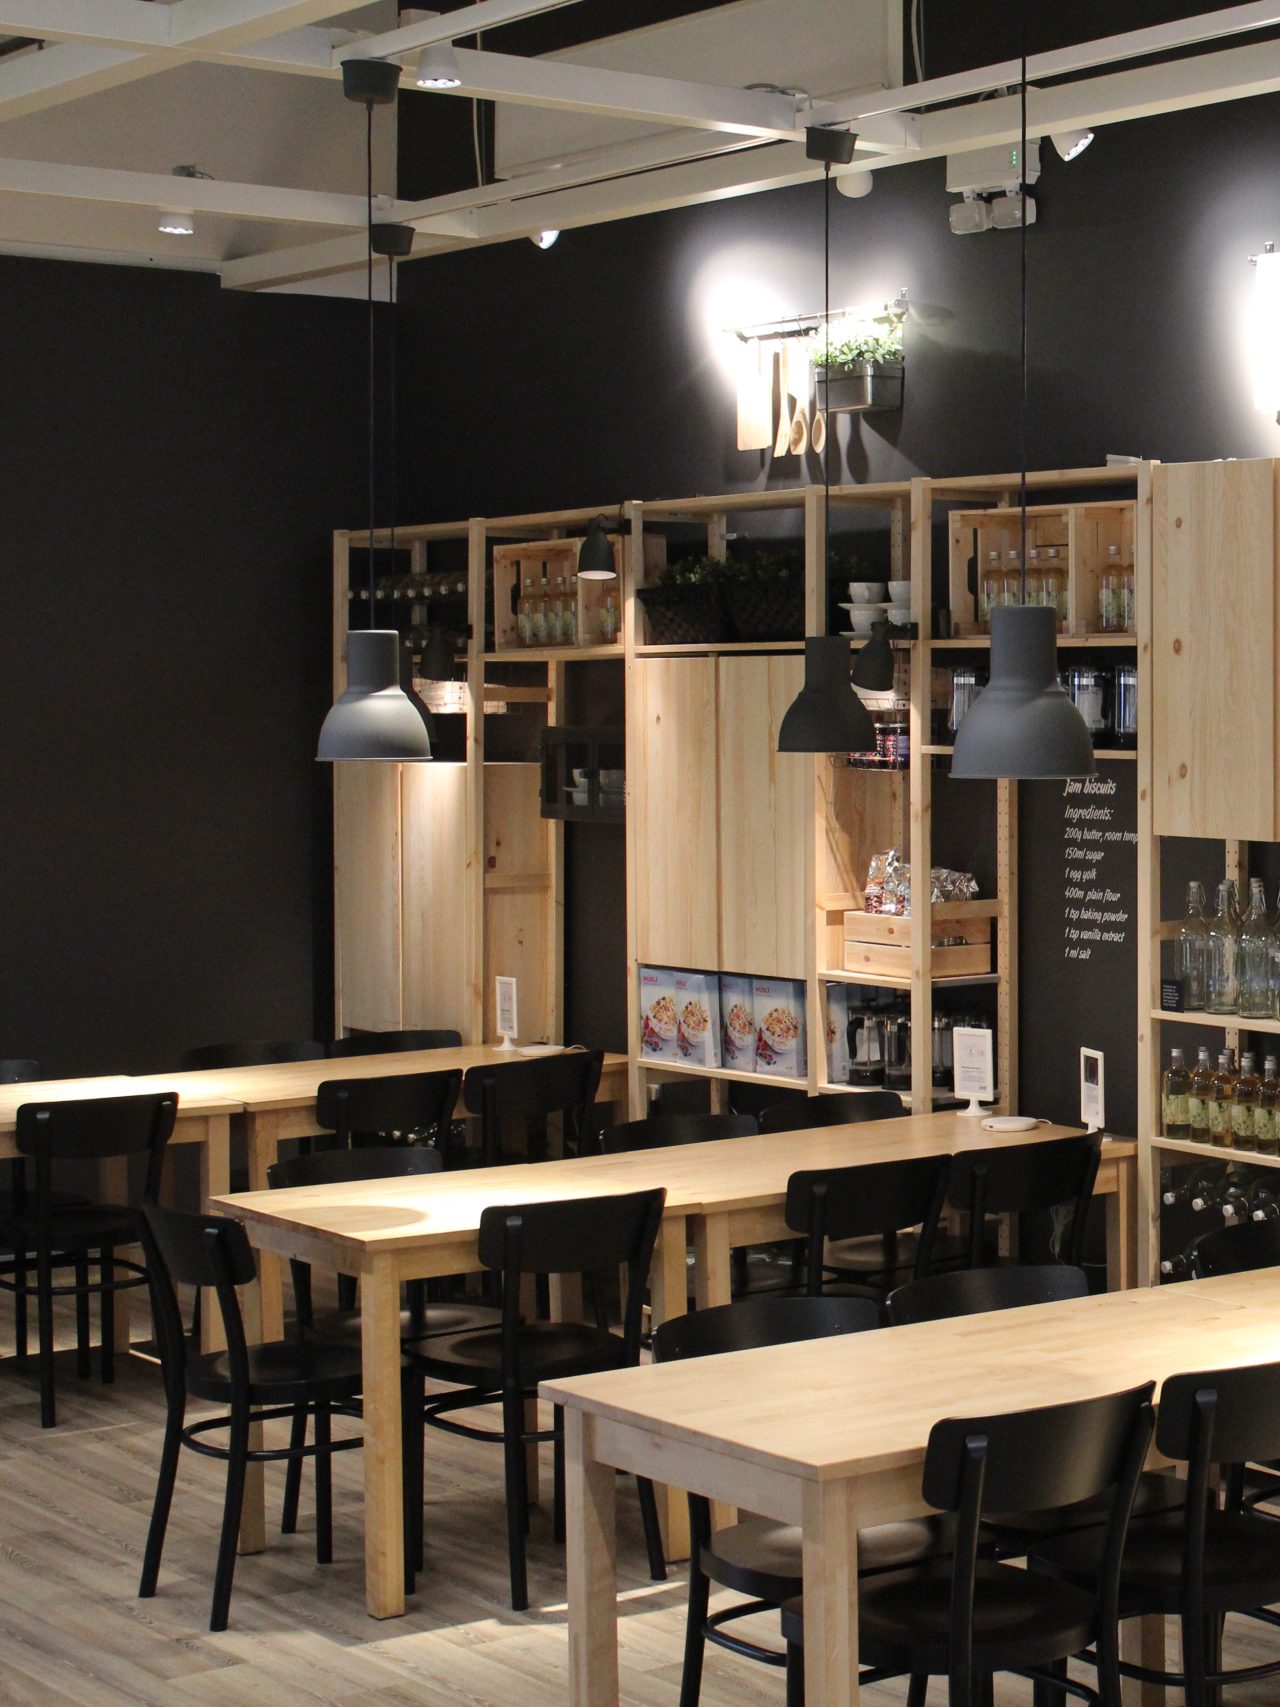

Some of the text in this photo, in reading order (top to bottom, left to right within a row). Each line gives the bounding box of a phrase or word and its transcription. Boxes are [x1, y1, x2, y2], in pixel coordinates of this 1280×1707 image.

[1063, 778, 1117, 797] Jam biscuits
[1065, 805, 1114, 823] Ingredients:
[1064, 827, 1082, 842] 200g
[1082, 828, 1103, 843] butter,
[1103, 831, 1123, 841] room
[1065, 847, 1104, 863] 150ml sugar
[1065, 867, 1097, 882] 1 egg yolk
[1085, 888, 1103, 903] plain
[1102, 888, 1121, 903] flour
[1065, 907, 1128, 924] 1 tsp baking powder
[1065, 926, 1125, 943] 1 tsp vanilla extract
[1065, 946, 1092, 960] 1 ml salt
